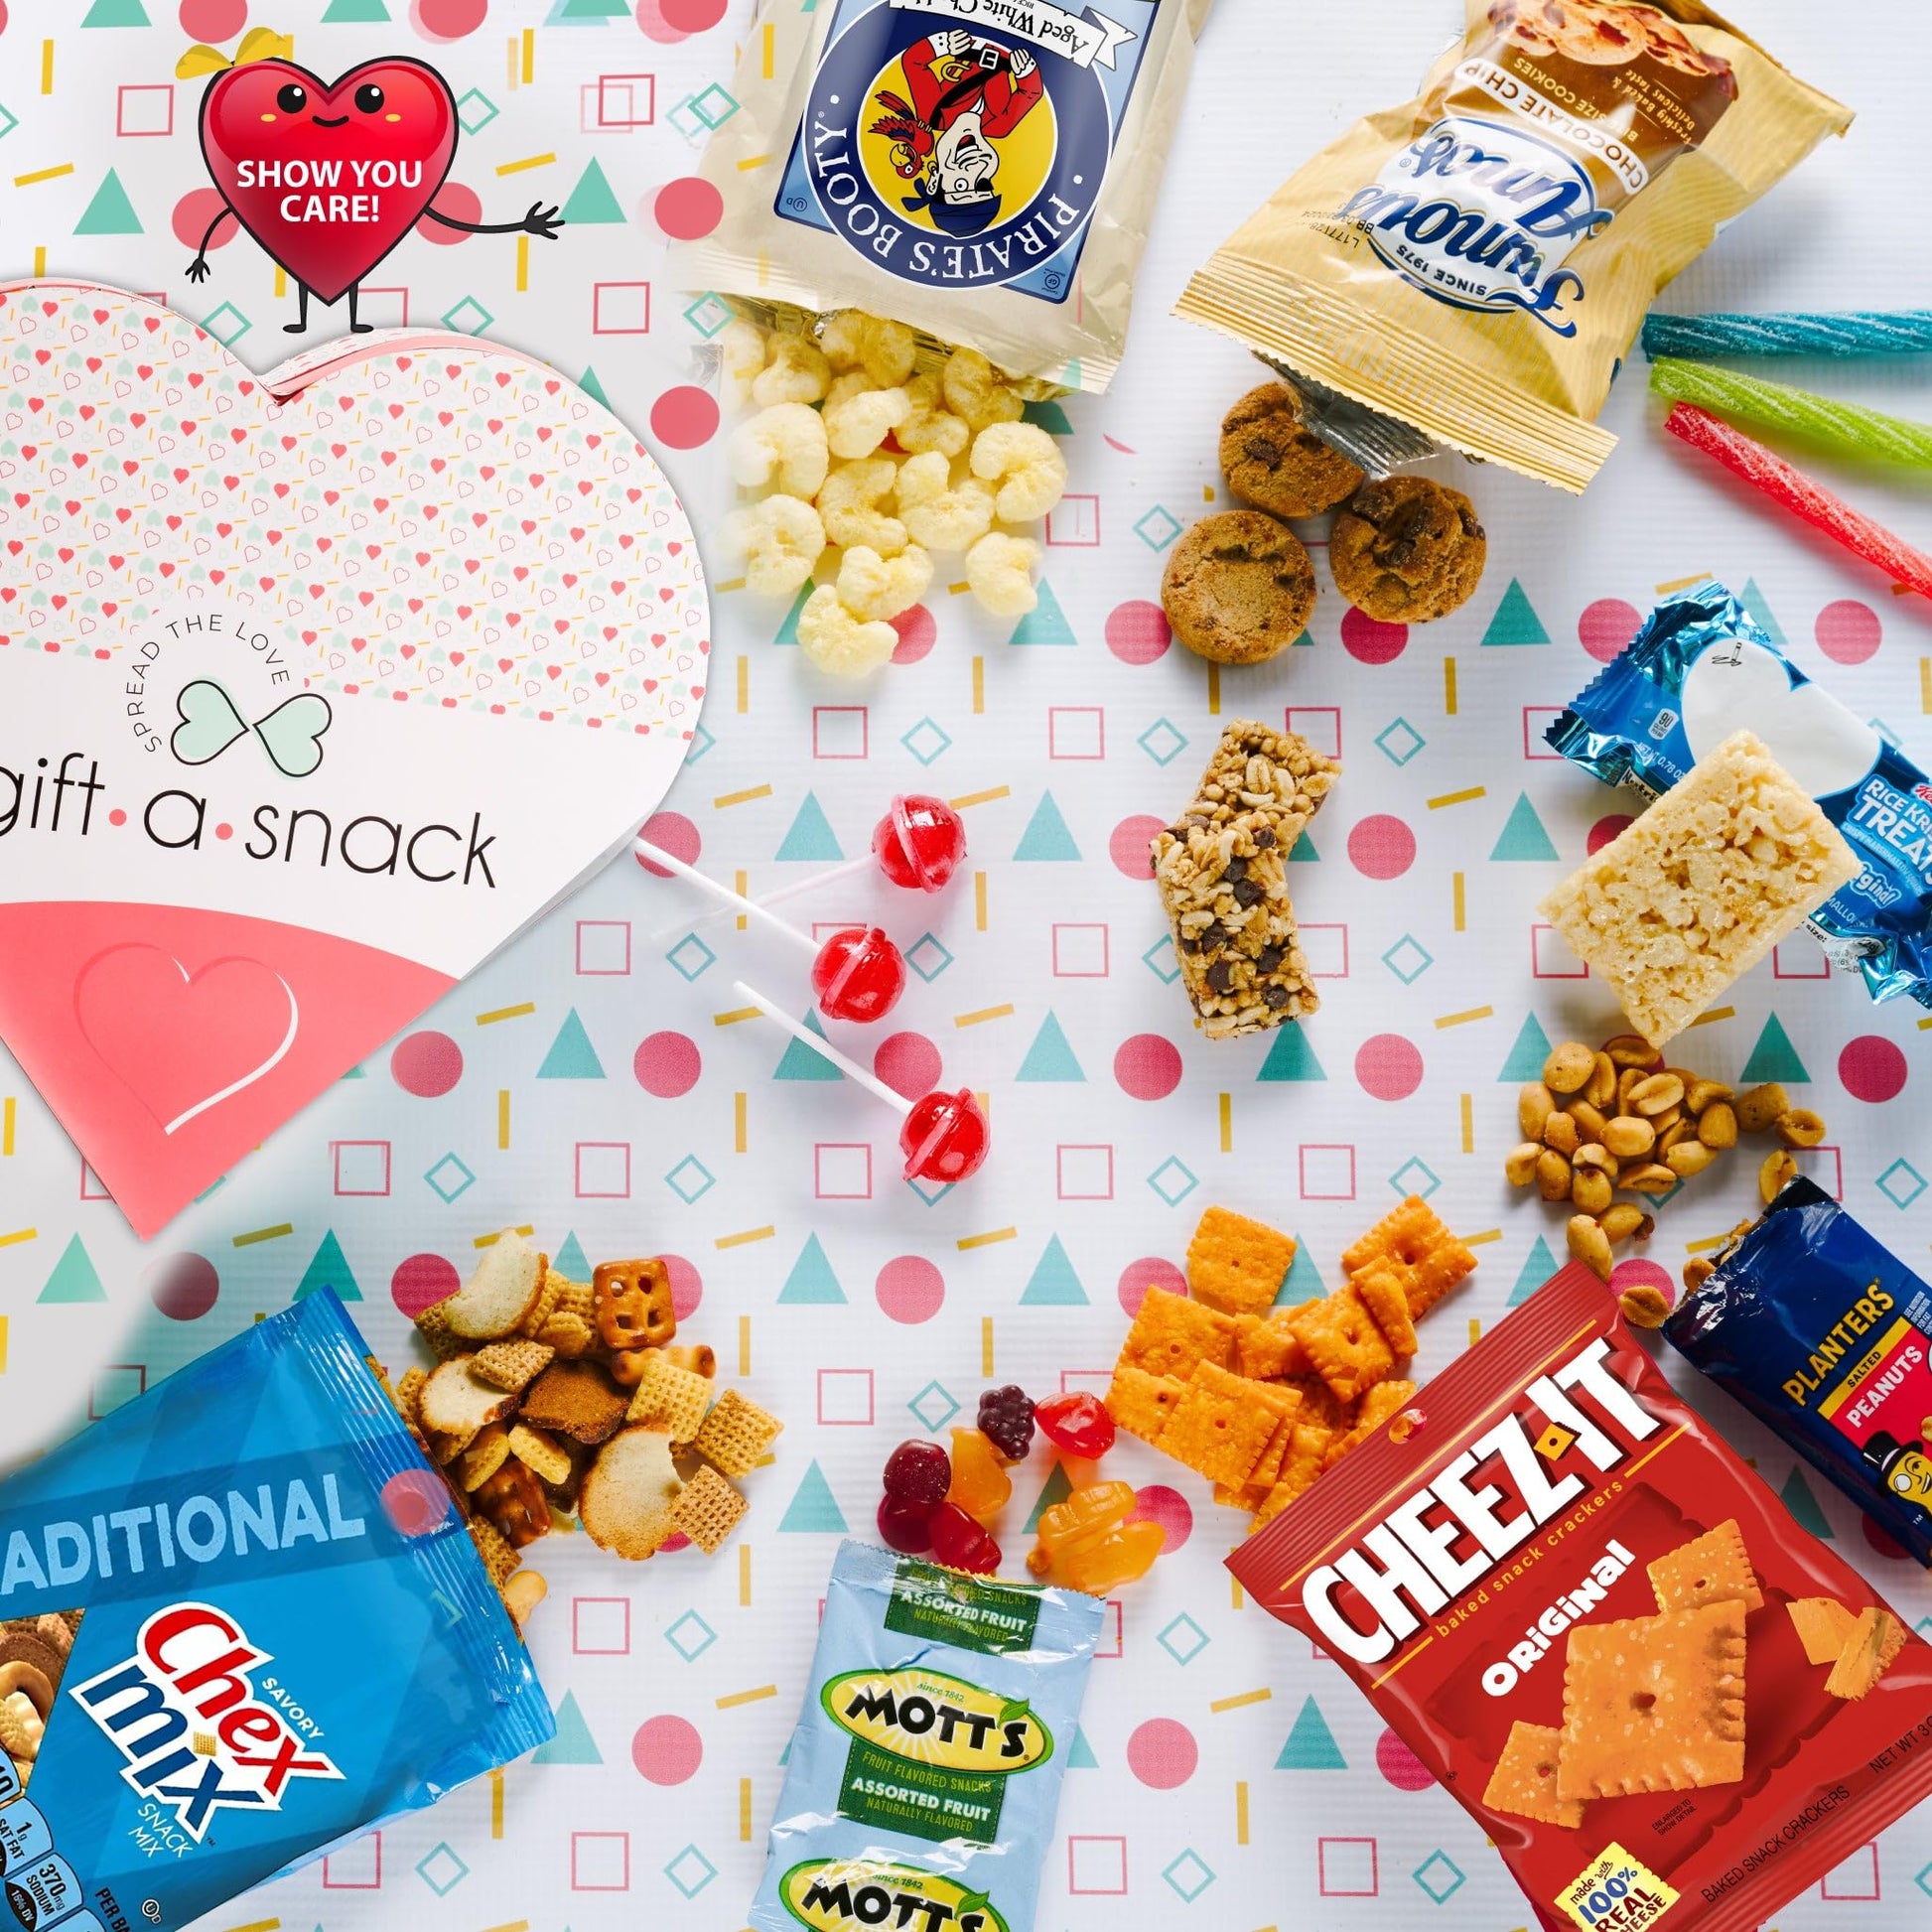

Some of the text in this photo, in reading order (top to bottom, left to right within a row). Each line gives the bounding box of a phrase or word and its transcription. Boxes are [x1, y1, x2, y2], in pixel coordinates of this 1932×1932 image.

[983, 0, 1090, 55] Aged White
[1513, 57, 1577, 104] COOKIES
[1625, 69, 1696, 132] Delicious Taste
[1464, 62, 1643, 189] CHOCOLATE CHIP
[1576, 98, 1608, 123] SIZE
[1610, 75, 1692, 145] Freshly Baked &
[814, 119, 1081, 279] PIRATE'S BOOTY
[1410, 133, 1614, 241] Amos
[1356, 219, 1375, 234] BB
[1336, 185, 1586, 339] Famous
[1395, 243, 1489, 297] SINCE 1975
[125, 614, 290, 753] SPREAD THE LOVE
[1659, 712, 1674, 729] 90
[1657, 756, 1676, 773] 0.78
[1864, 778, 1908, 813] RICE
[0, 752, 497, 889] gift a snack
[1806, 923, 1828, 943] size:
[1781, 1284, 1895, 1408] PLANTERS
[1846, 1345, 1924, 1430] PEANUTS
[1847, 1349, 1882, 1390] SALTED
[1435, 1478, 1624, 1638] baked snack crackers
[900, 1590, 1028, 1633] ASSORTED FRUIT
[989, 1590, 1028, 1605] SNACKS
[144, 1608, 331, 1798] Chex
[261, 1677, 325, 1738] SAVORY
[916, 1681, 966, 1703] since 1842
[844, 1683, 1029, 1759] MOTT'S
[861, 1750, 993, 1795] FRUIT FLAVORED SNACKS
[850, 1776, 992, 1823] ASSORTED FRUIT
[865, 1796, 974, 1833] NATURALLY FLAVORED
[1651, 1798, 1692, 1831] ENLARGED TO
[1657, 1805, 1698, 1836] SHOW DETAIL
[1701, 1865, 1745, 1904] BAKED
[1741, 1836, 1787, 1872] SNACK
[1781, 1784, 1852, 1841] CRACKERS
[1867, 1745, 1898, 1774] NET
[1896, 1730, 1921, 1753] WT
[7, 1839, 26, 1860] FAT
[127, 1826, 165, 1859] MIX
[137, 1802, 194, 1859] SNACK
[10, 1889, 36, 1922] 16% DV
[26, 1873, 57, 1917] SODIUM
[94, 1886, 121, 1920] PER
[899, 1876, 924, 1891] 1842
[1570, 1861, 1614, 1905] made with
[1578, 1866, 1639, 1925] 100%
[1593, 1887, 1657, 1932] REAL
[1619, 1891, 1667, 1932] HEESE
